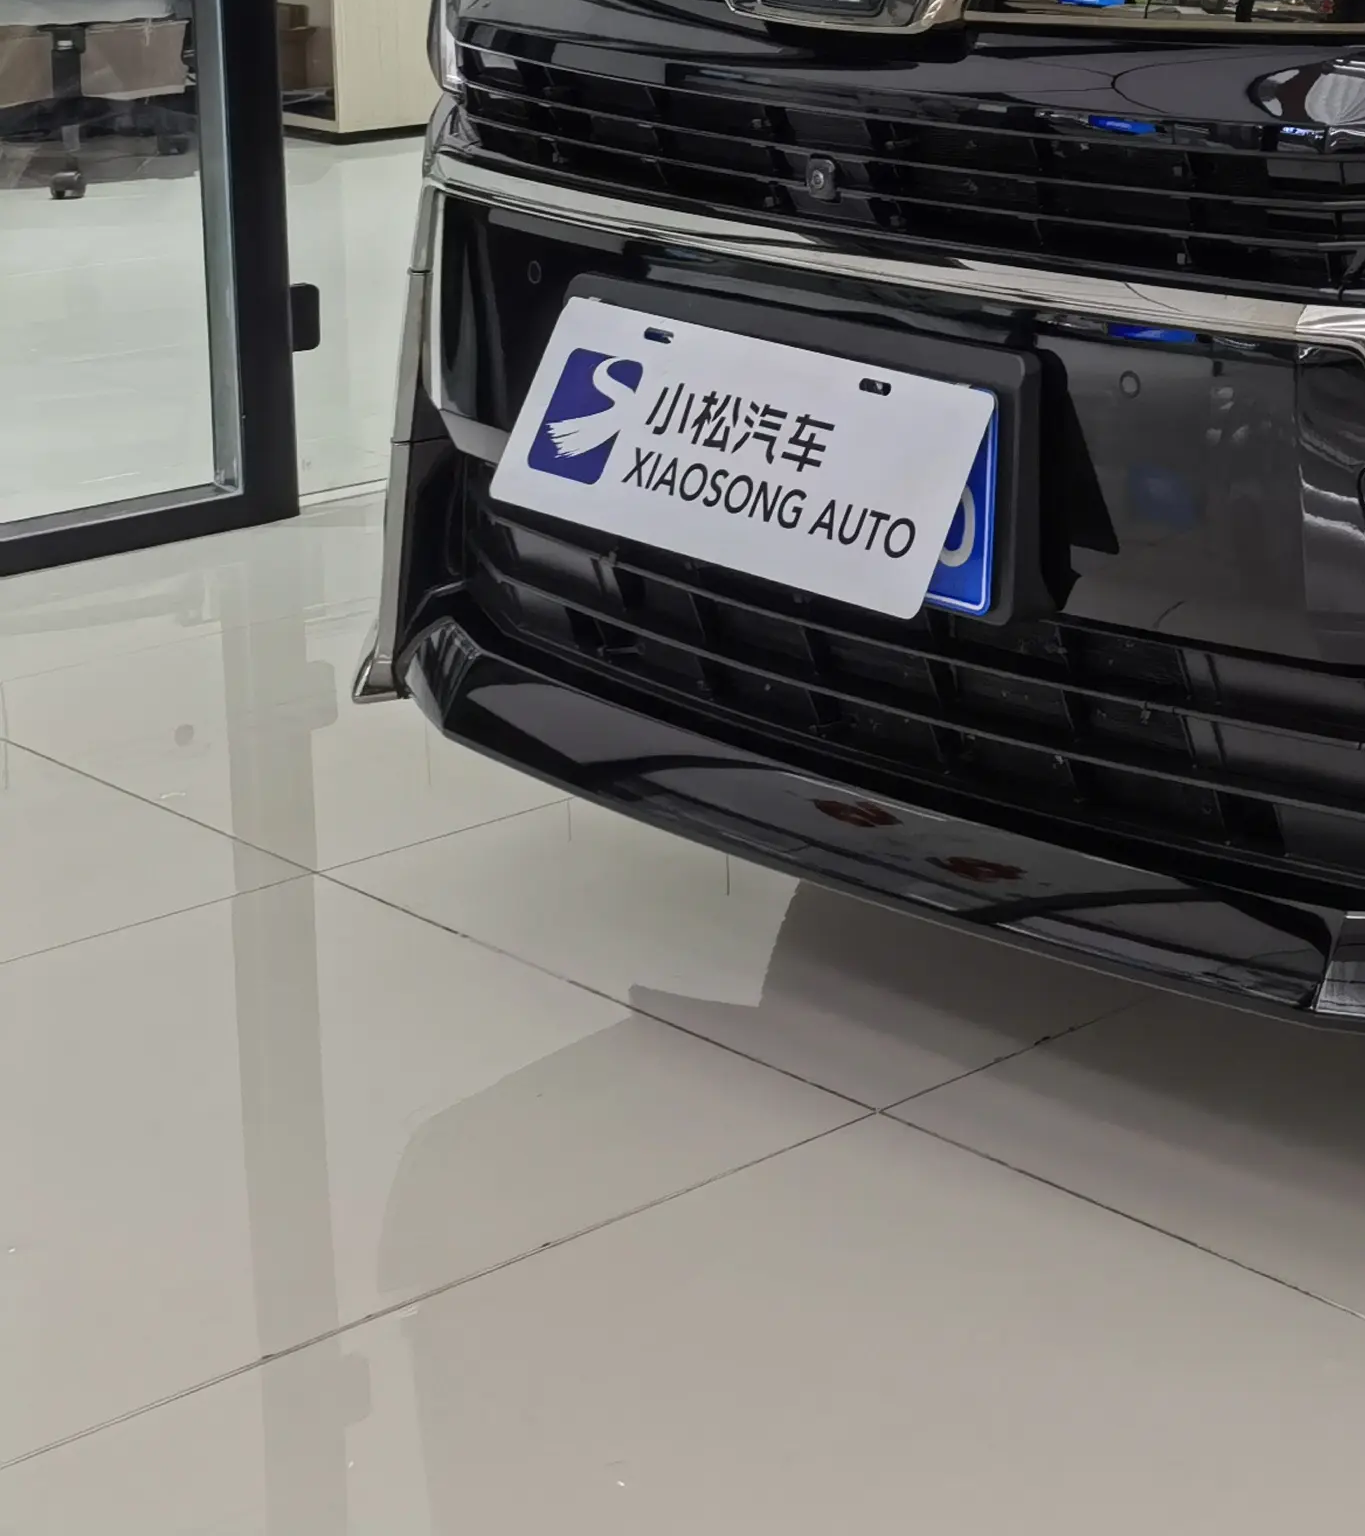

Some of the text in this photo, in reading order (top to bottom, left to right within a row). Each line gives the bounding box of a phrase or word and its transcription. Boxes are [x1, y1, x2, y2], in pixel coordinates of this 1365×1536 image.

[645, 382, 836, 472] 小松汽车
[621, 447, 808, 530] XIAOSONG
[808, 498, 917, 559] AUTO
